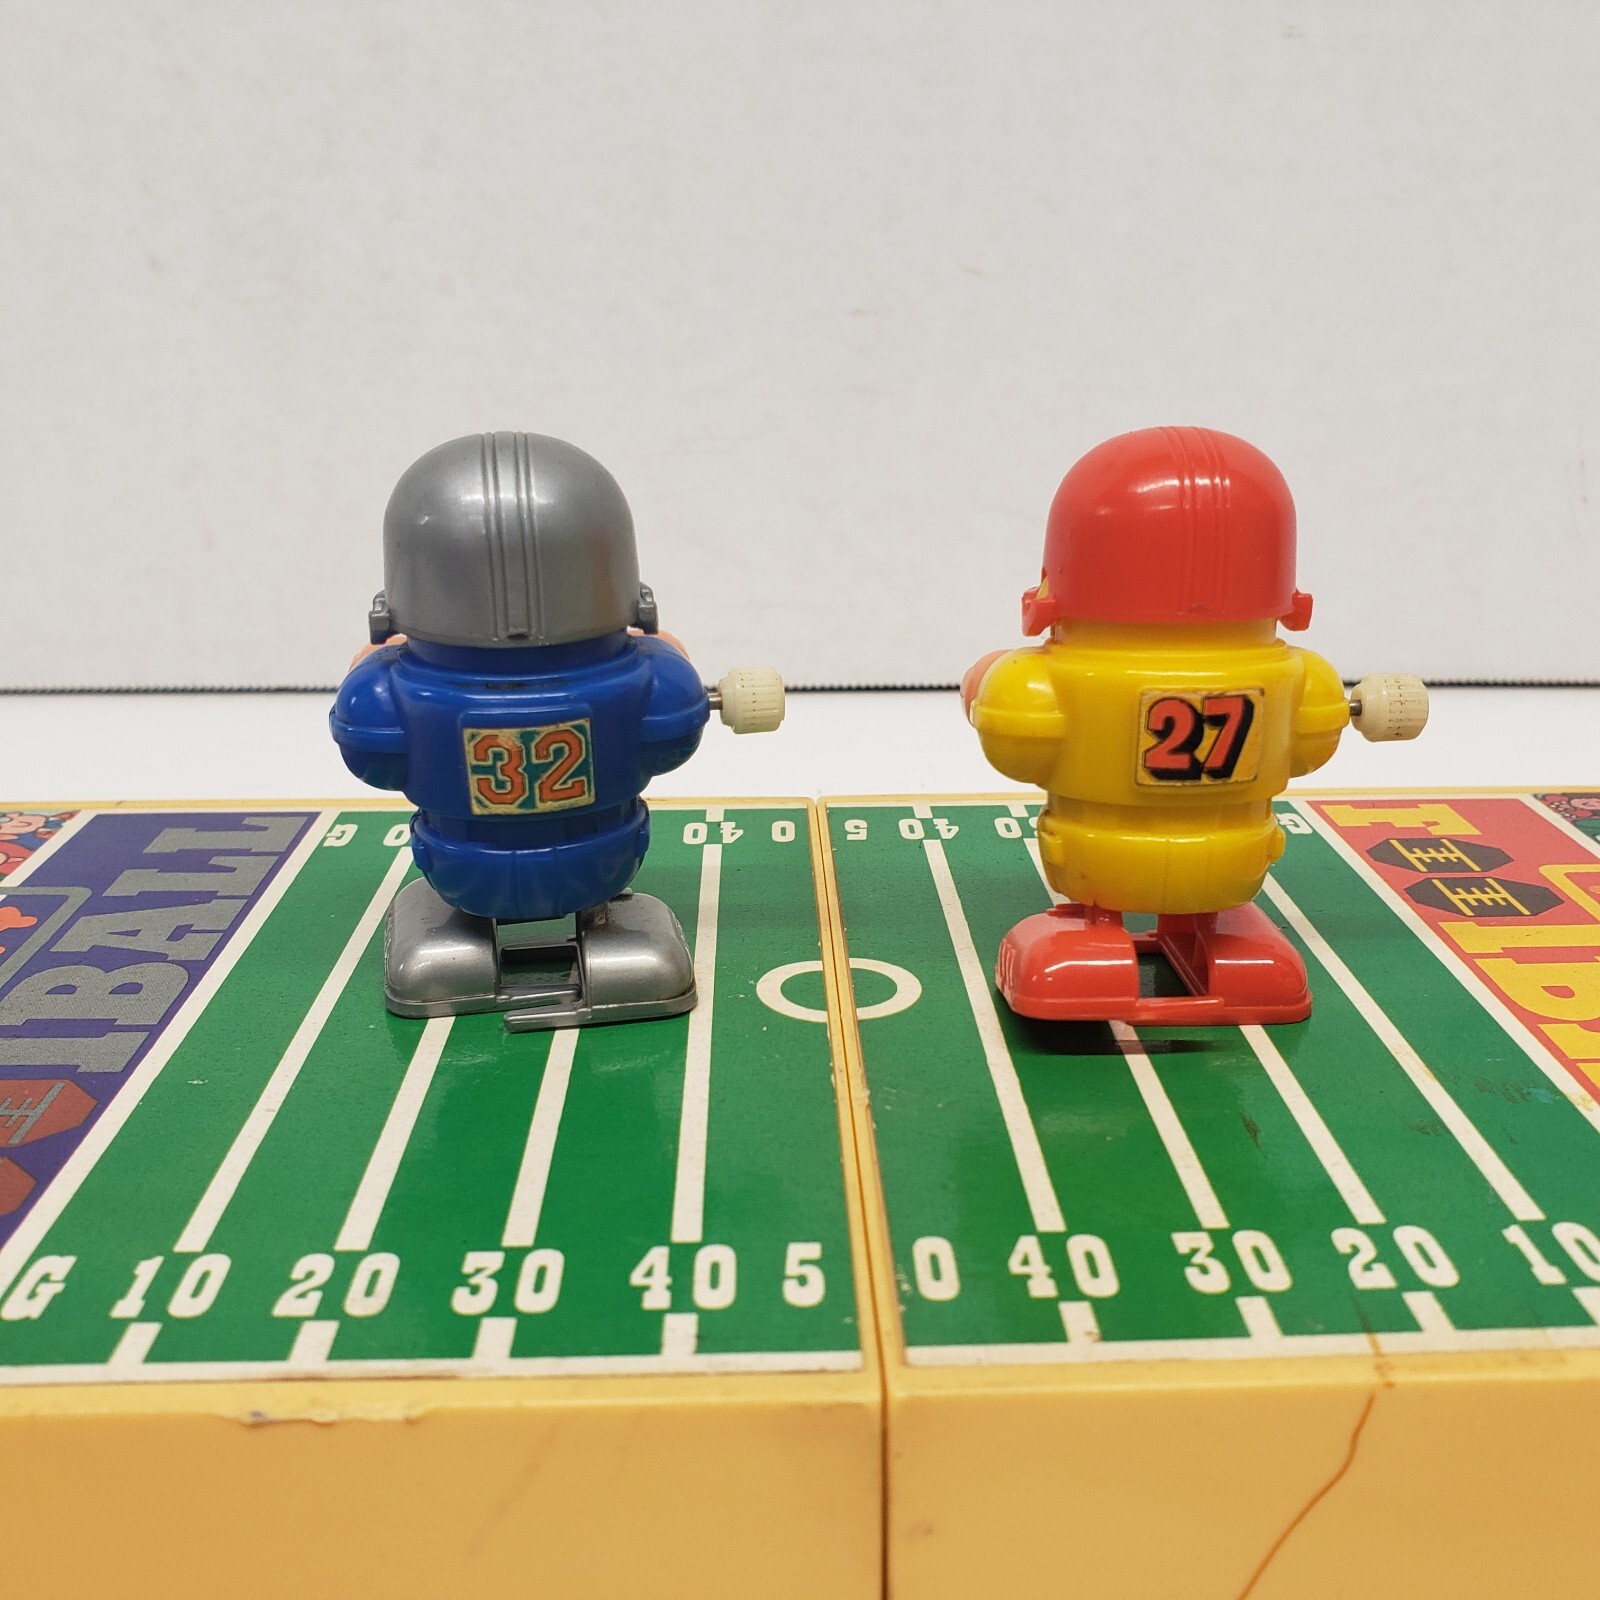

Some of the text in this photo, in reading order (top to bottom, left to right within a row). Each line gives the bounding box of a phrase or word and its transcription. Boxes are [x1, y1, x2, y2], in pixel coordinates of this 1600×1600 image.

[473, 729, 586, 805] 32
[1144, 695, 1254, 781] 27
[682, 821, 744, 845] 40
[898, 818, 960, 840] 40
[110, 1252, 232, 1318] 10
[272, 1252, 401, 1317] 20
[452, 1248, 565, 1314] 30
[630, 1243, 737, 1310] 40
[1007, 1234, 1119, 1298] 40
[1171, 1229, 1292, 1292] 30
[1331, 1225, 1460, 1290] 20
[1501, 1221, 1600, 1286] 10
[1, 1254, 77, 1320] G
